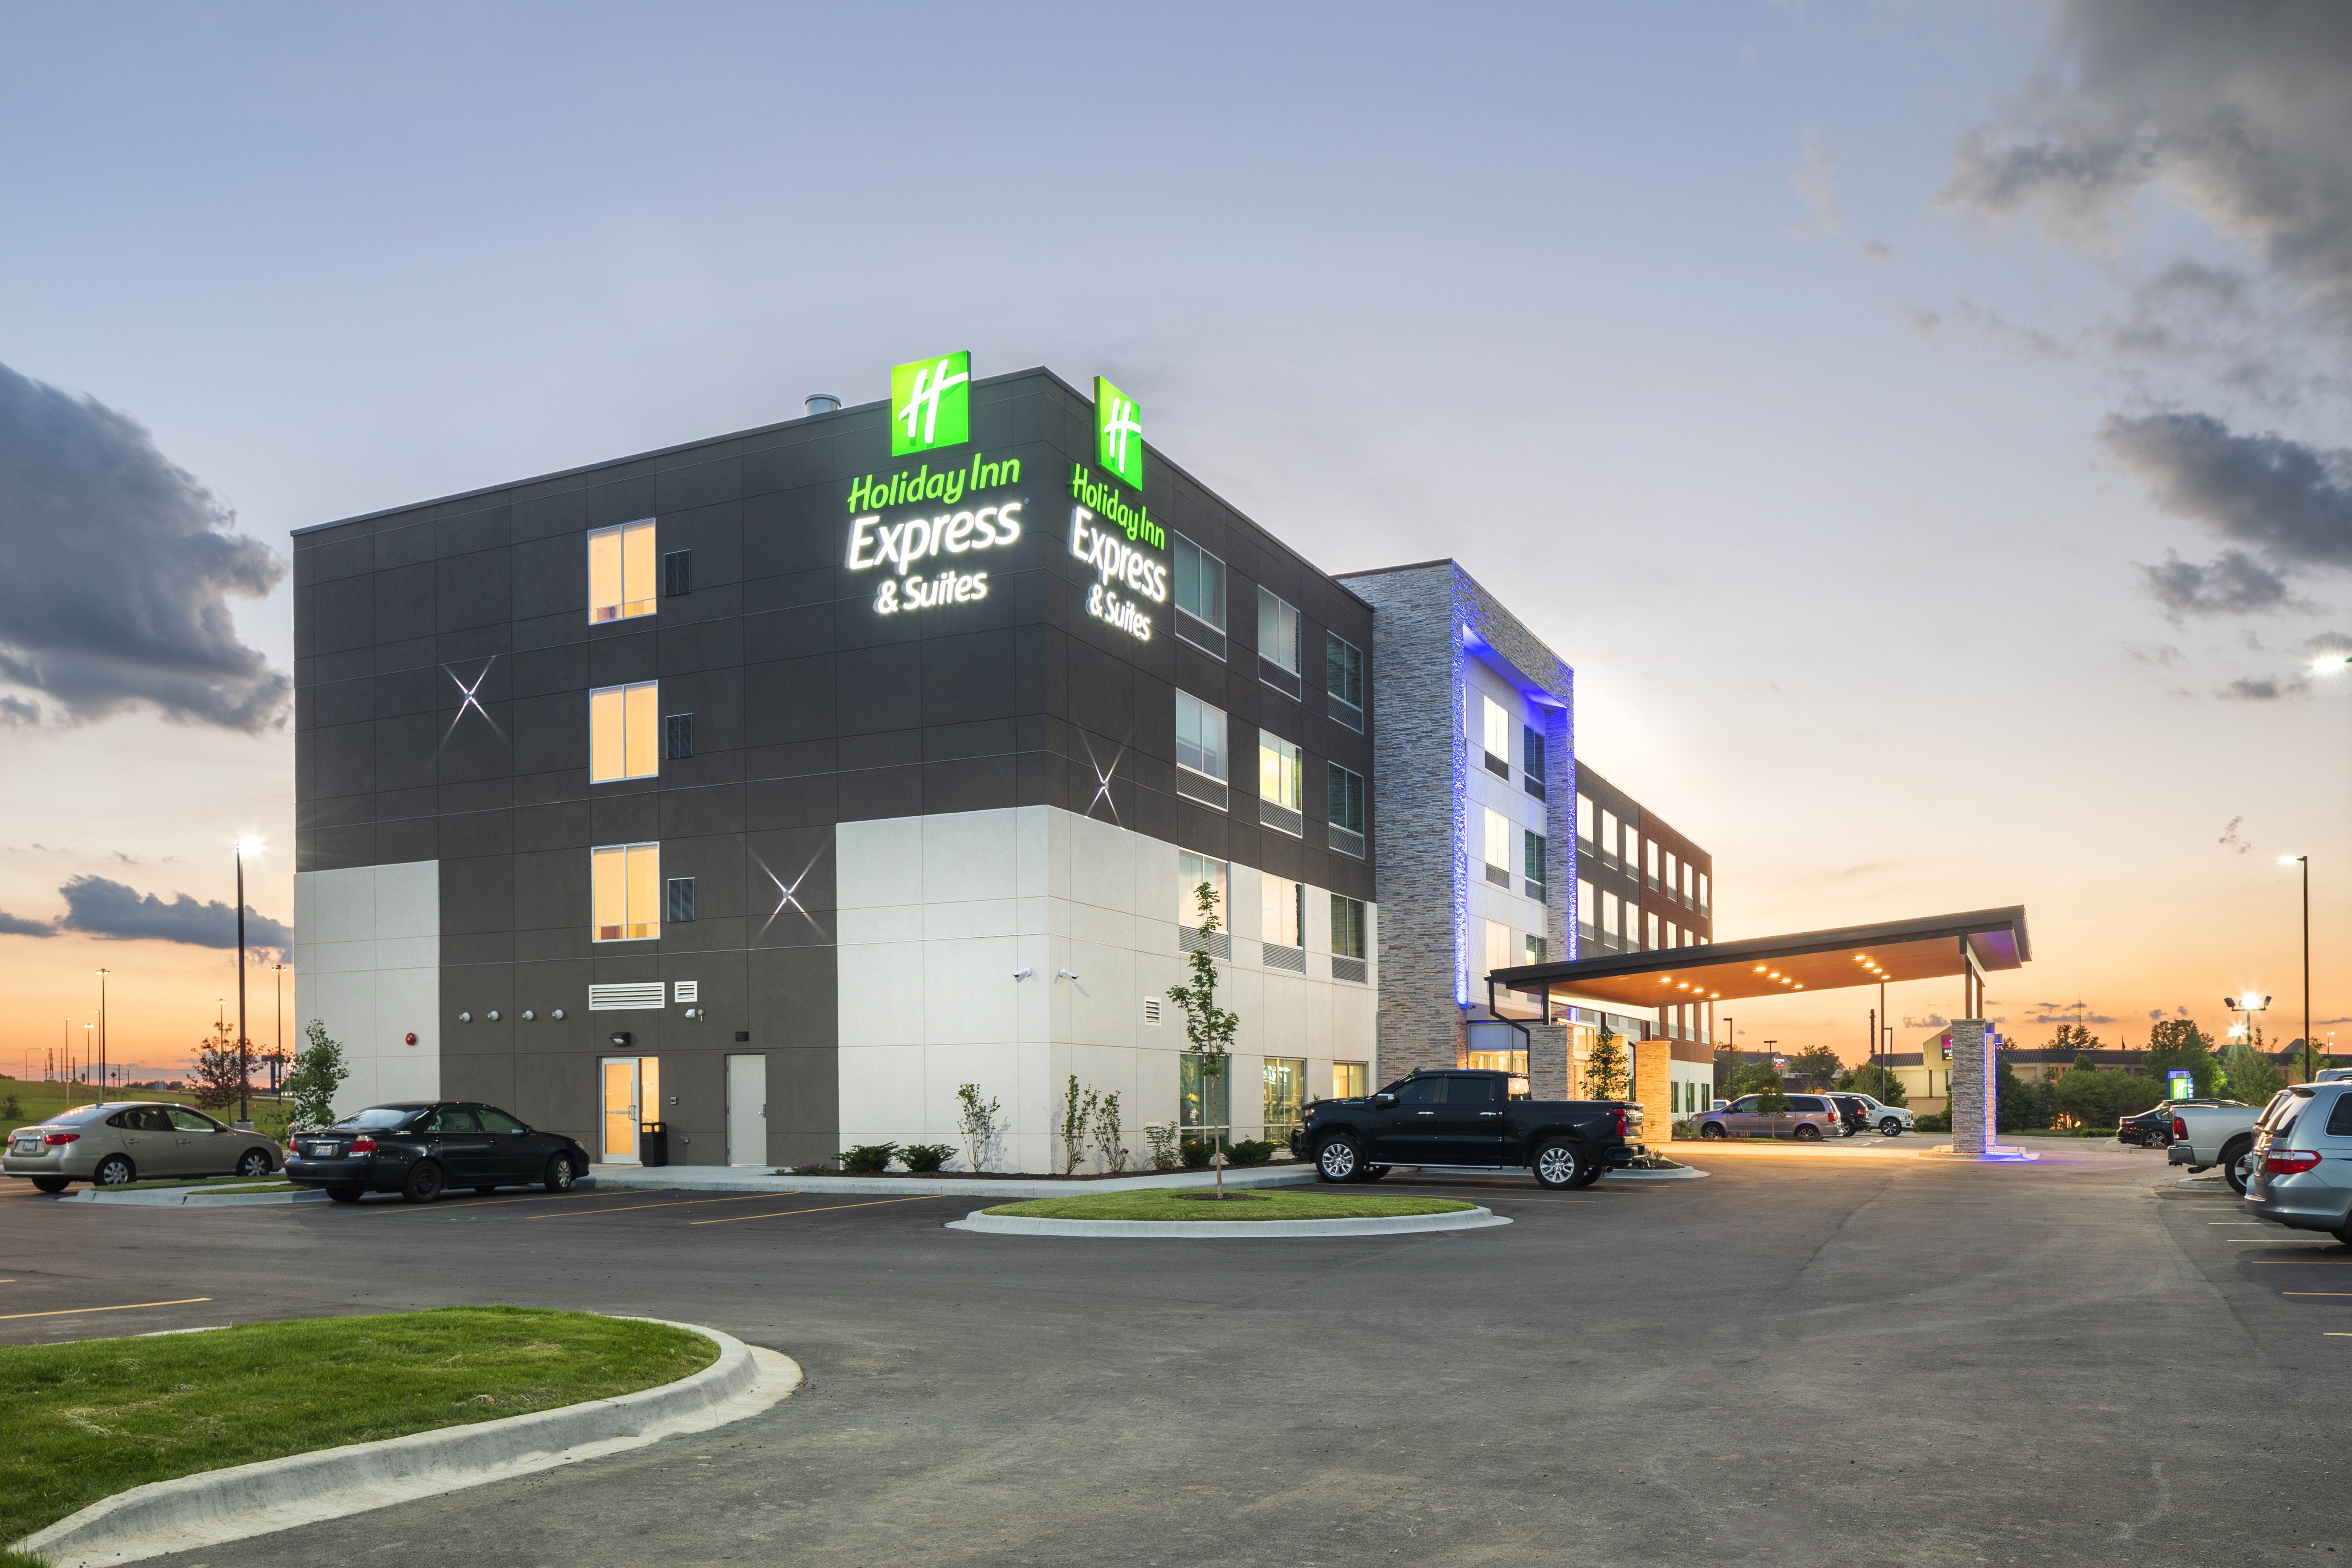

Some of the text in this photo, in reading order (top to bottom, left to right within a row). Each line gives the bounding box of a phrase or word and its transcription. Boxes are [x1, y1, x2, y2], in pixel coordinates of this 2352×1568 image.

[847, 453, 1020, 513] Holiday Inn
[1072, 463, 1165, 551] Holiday Inn
[848, 503, 1022, 575] Express
[1073, 506, 1166, 602] Express
[877, 571, 987, 614] & Suites
[1090, 584, 1151, 640] & Suites
